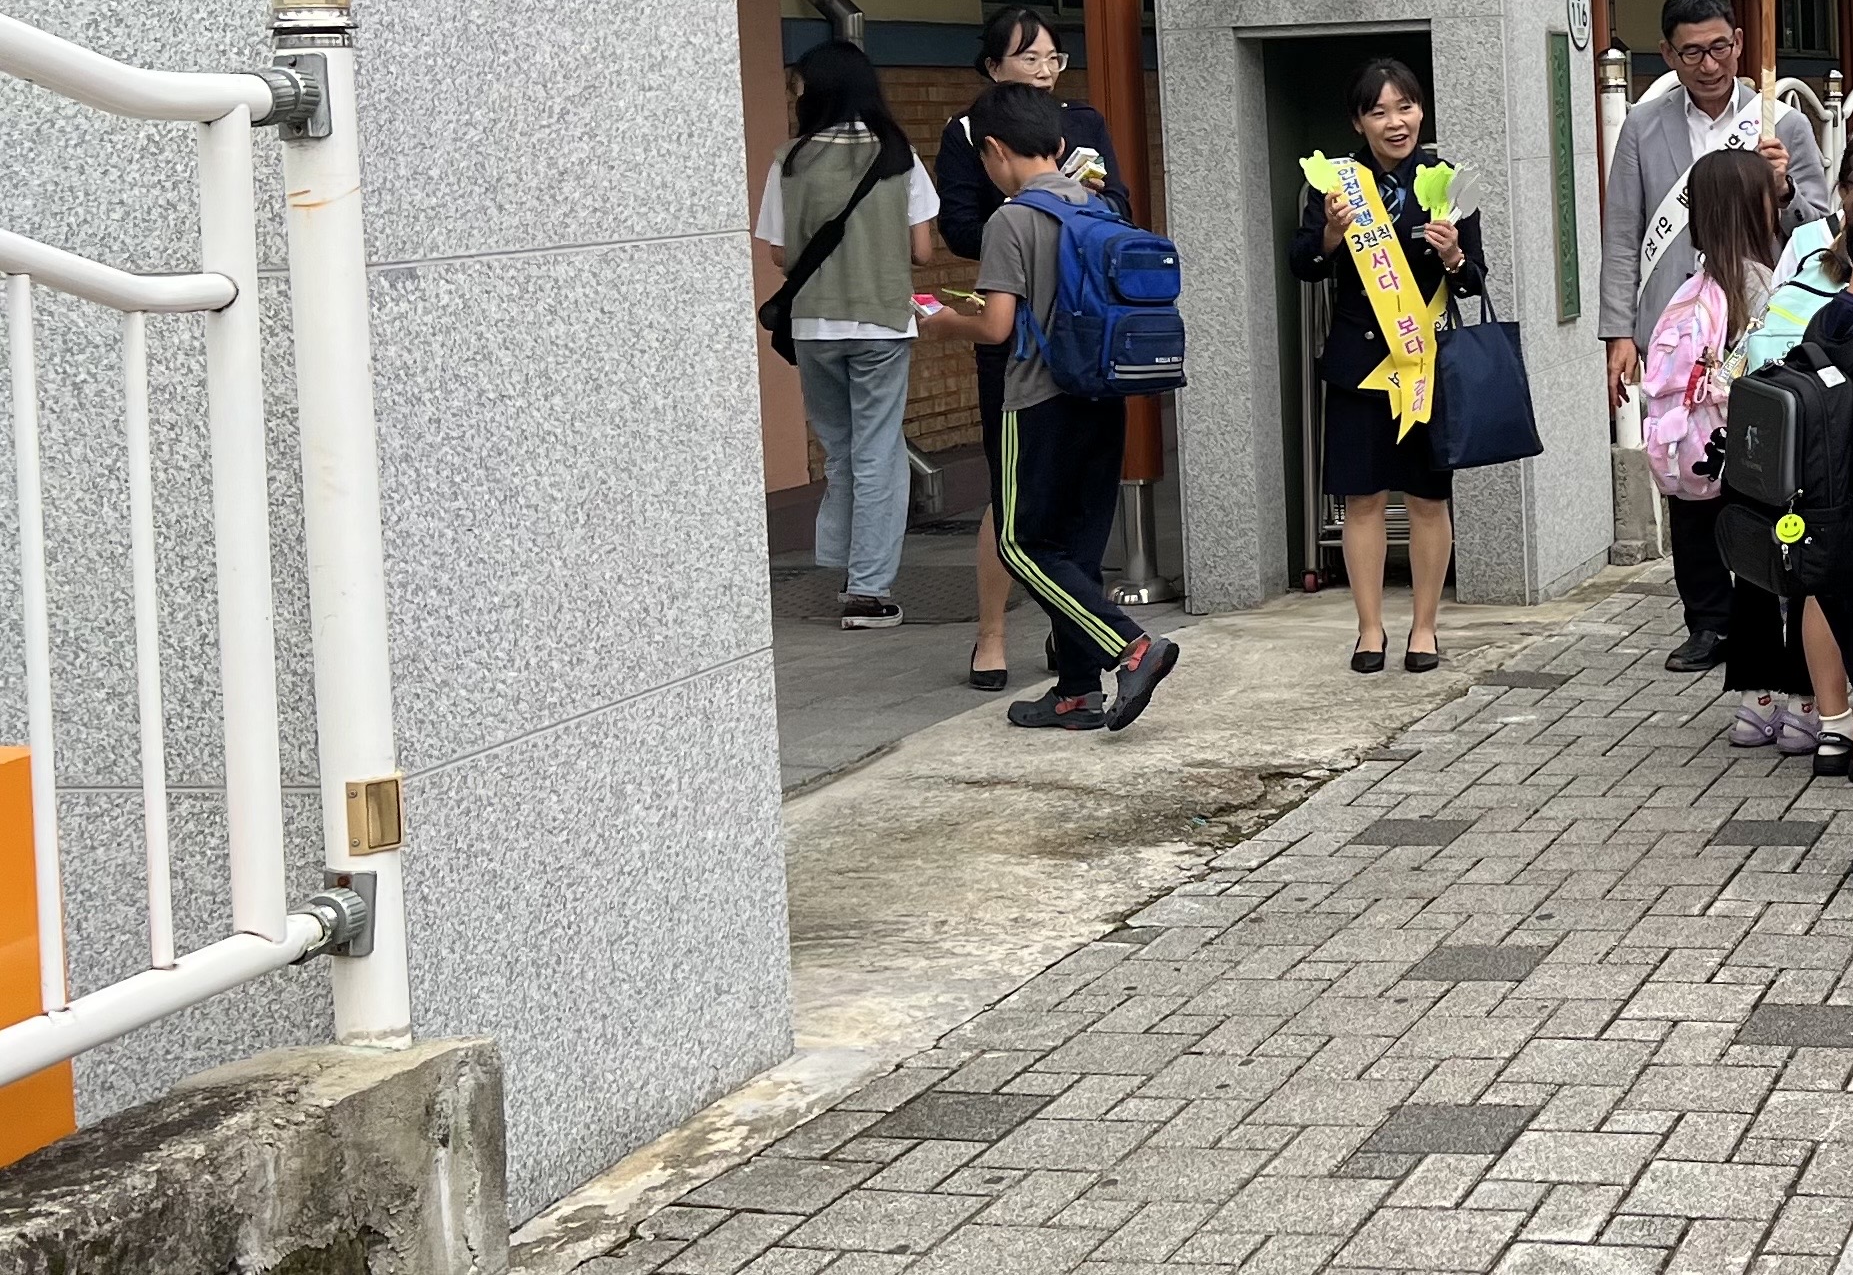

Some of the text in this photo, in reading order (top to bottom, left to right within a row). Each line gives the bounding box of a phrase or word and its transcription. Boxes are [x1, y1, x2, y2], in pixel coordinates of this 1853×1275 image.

[1572, 2, 1587, 27] 116
[1351, 224, 1392, 253] 3원칙
[1645, 216, 1673, 262] 안전
[1371, 248, 1400, 291] 서다
[1398, 315, 1424, 355] 보다
